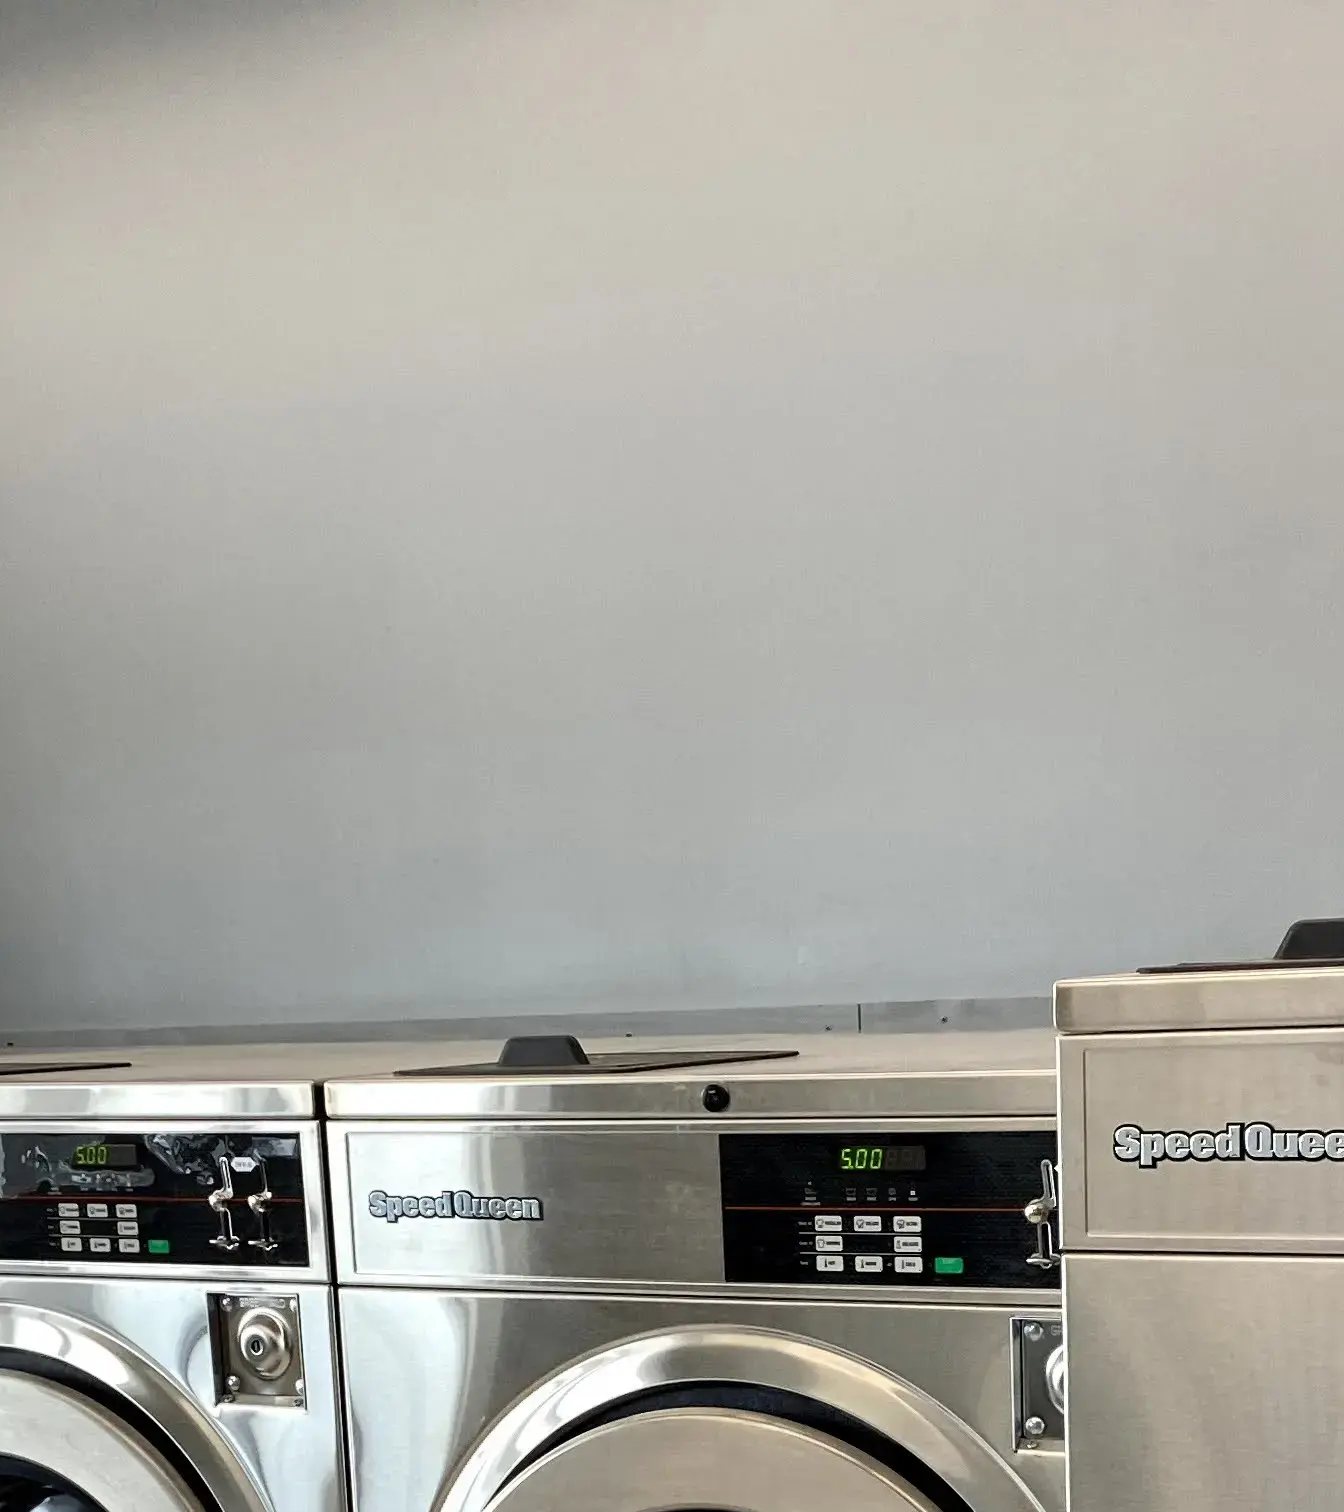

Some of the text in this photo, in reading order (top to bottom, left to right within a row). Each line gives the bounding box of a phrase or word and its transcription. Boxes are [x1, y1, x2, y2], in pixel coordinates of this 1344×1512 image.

[75, 1145, 107, 1165] 5.00
[840, 1148, 884, 1170] 5.00
[1113, 1122, 1245, 1169] Speed
[368, 1190, 544, 1223] Speed Queen
